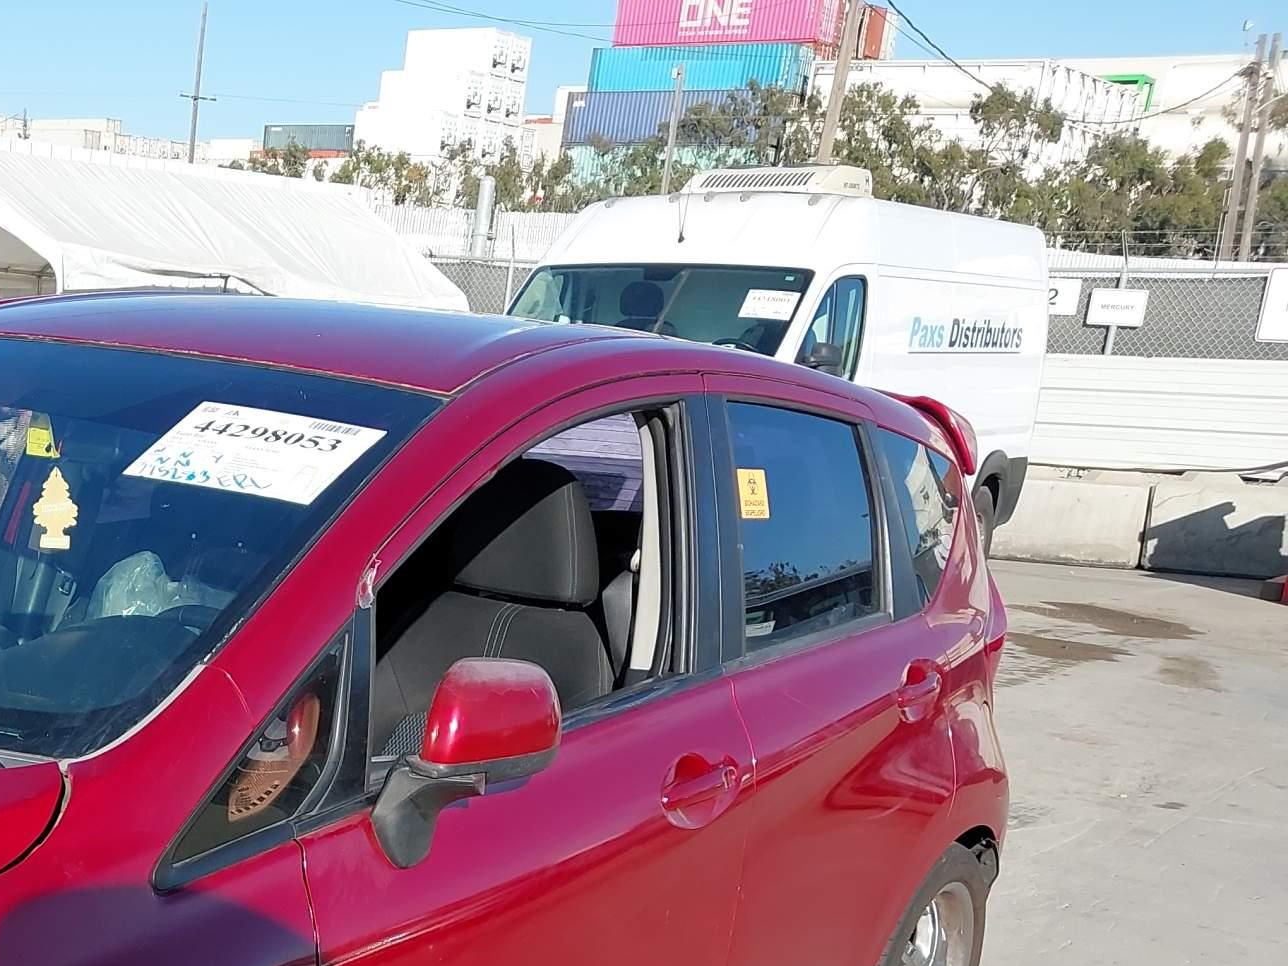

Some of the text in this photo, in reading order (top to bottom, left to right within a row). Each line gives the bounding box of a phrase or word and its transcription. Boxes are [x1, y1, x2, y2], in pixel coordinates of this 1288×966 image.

[679, 0, 752, 27] ONE
[1100, 303, 1135, 311] MERCURY
[908, 316, 1023, 349] Paxs Distributors
[194, 419, 342, 452] 44298053
